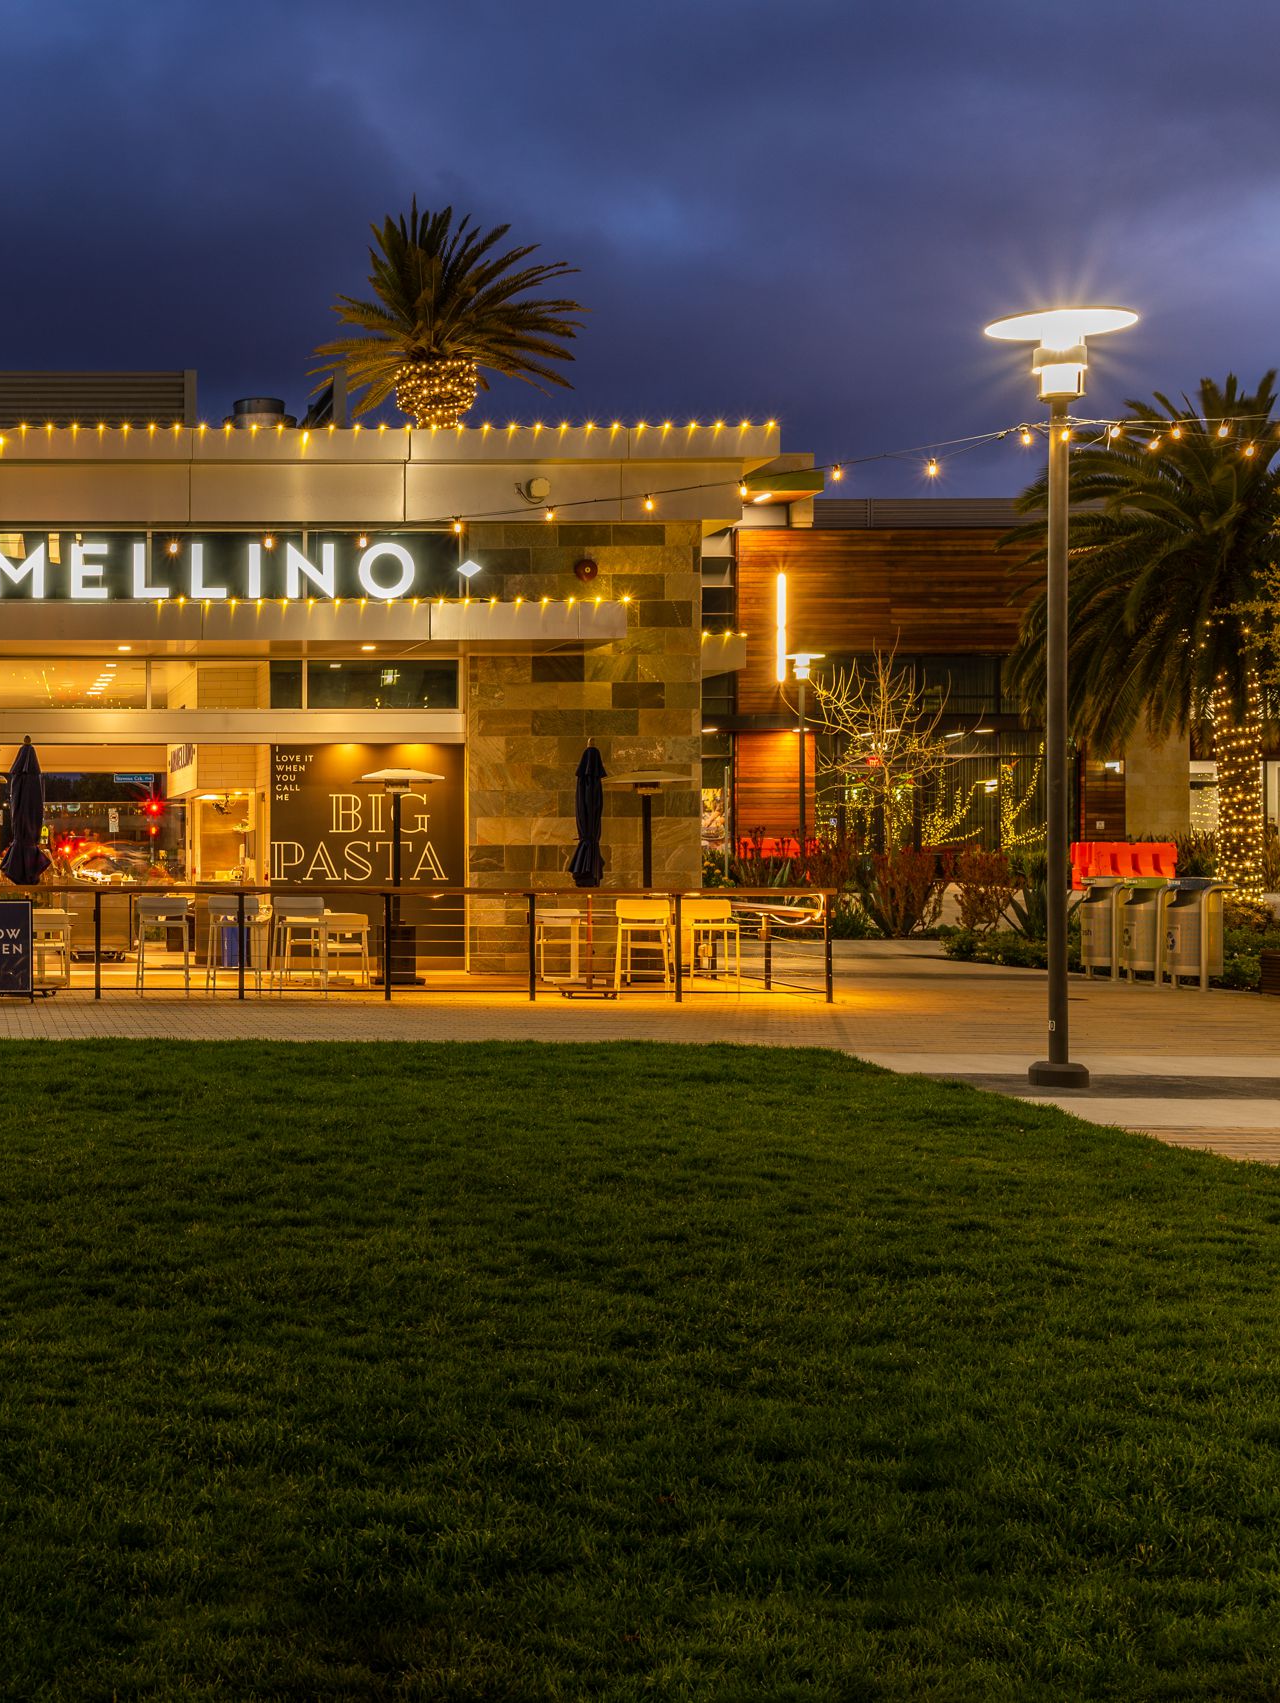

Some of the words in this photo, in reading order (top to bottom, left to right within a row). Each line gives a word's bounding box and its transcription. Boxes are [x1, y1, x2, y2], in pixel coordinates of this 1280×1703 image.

[275, 764, 306, 772] WHEN
[329, 793, 431, 834] BIG
[270, 841, 449, 881] PASTA
